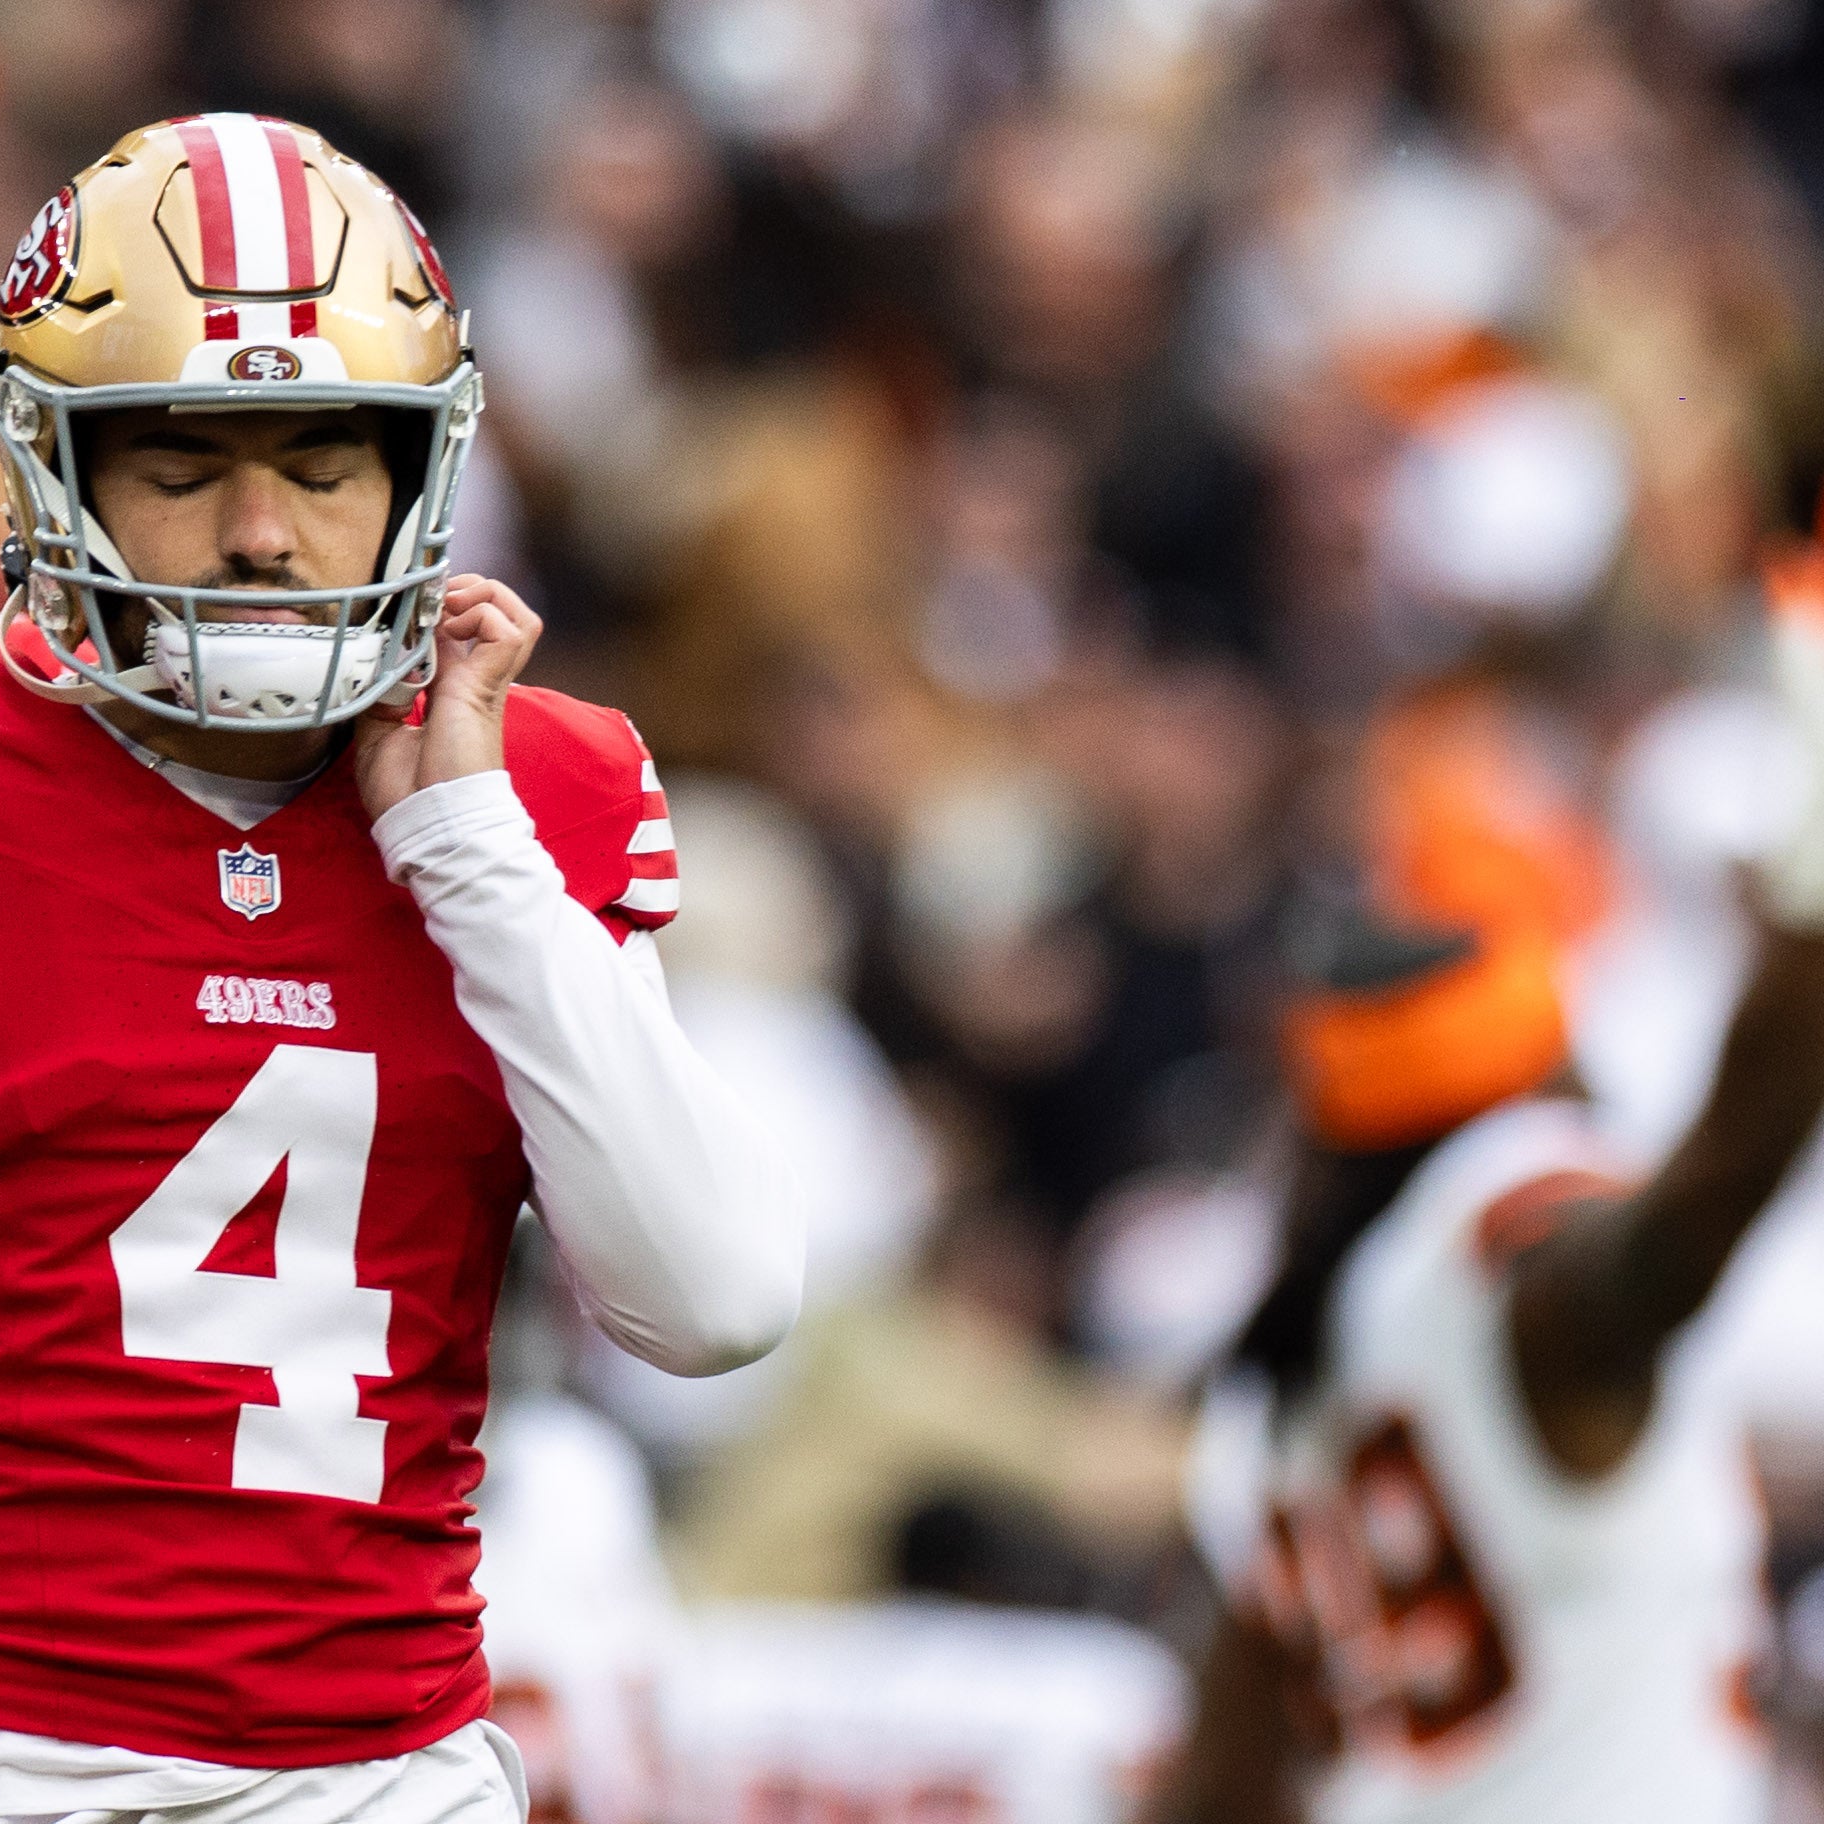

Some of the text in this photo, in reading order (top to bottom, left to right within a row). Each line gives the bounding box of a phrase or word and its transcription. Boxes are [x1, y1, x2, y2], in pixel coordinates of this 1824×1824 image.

[232, 876, 272, 904] NFL
[196, 975, 337, 1030] 49ERS
[109, 1043, 393, 1505] 4
